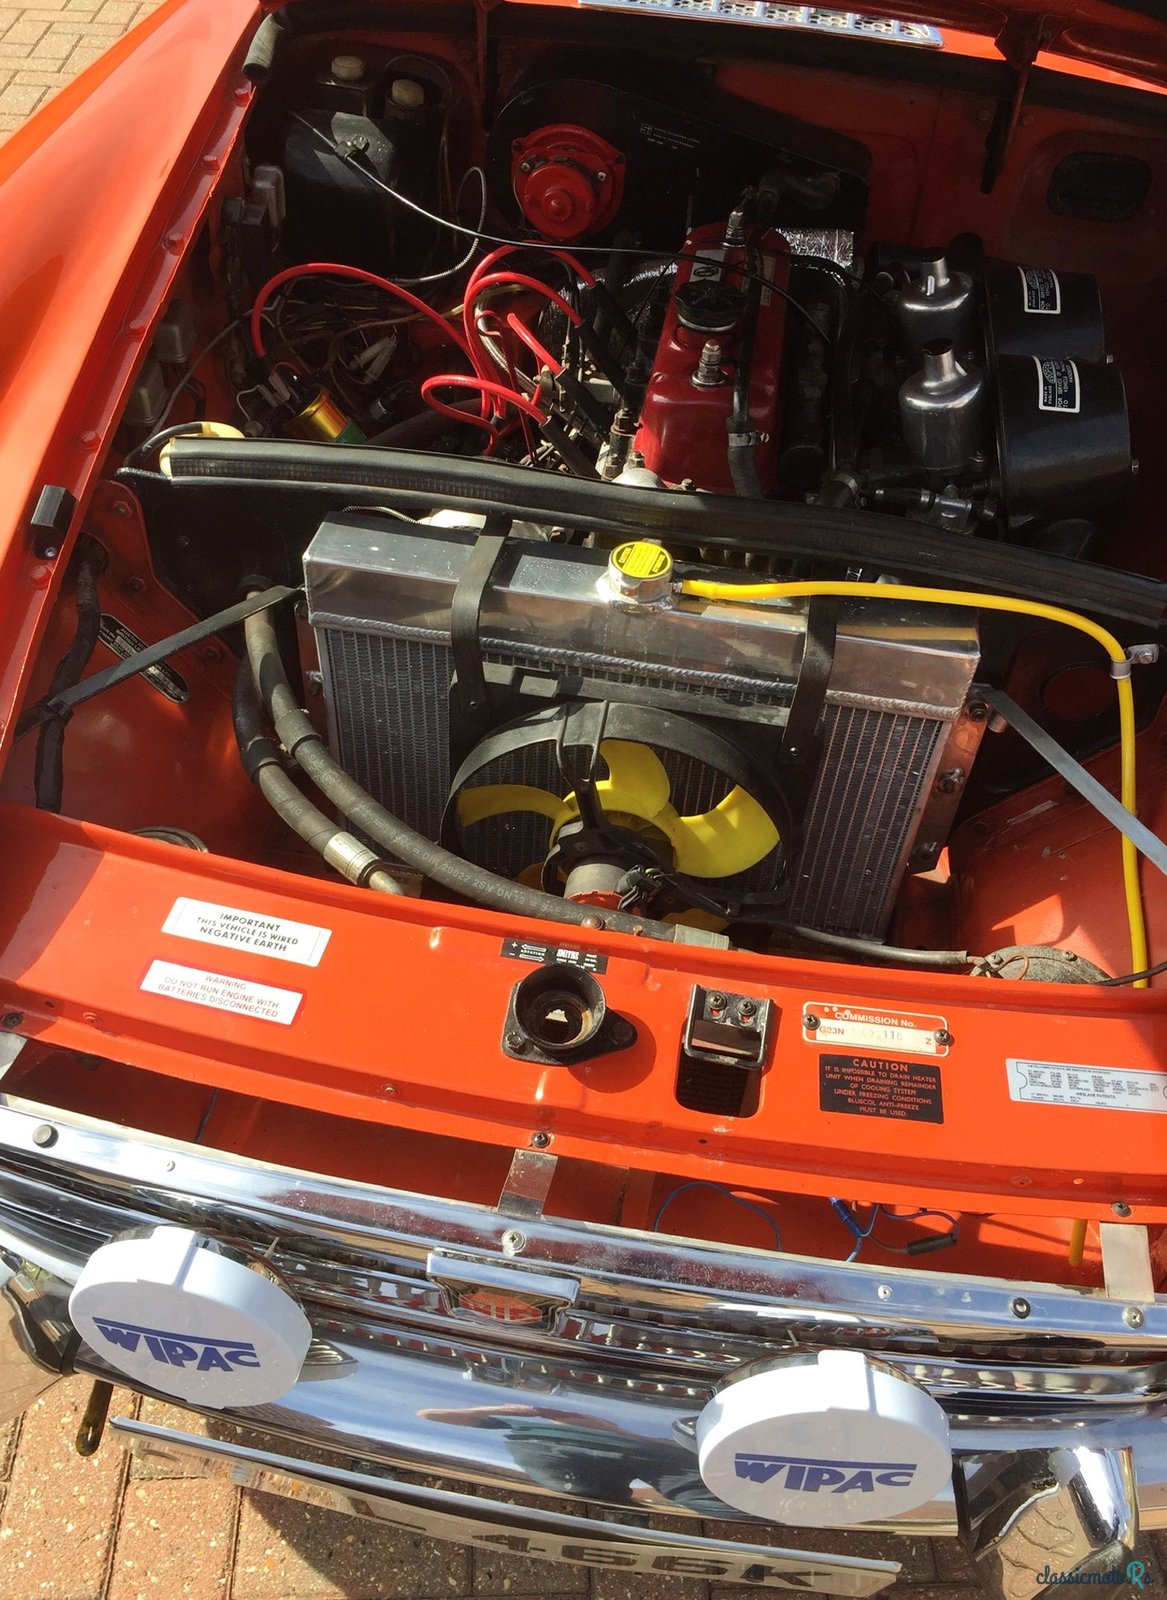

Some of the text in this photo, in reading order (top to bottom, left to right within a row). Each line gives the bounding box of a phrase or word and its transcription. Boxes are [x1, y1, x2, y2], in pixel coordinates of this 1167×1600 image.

[422, 852, 439, 867] DIN
[441, 862, 470, 883] 20022
[472, 878, 494, 893] 2SN
[197, 917, 217, 927] THIS
[220, 921, 256, 936] VEHICLE
[270, 933, 298, 945] WIRED
[220, 913, 281, 932] IMPORTANT
[200, 926, 288, 952] NEGATIVE EARTH
[205, 975, 246, 990] WARNING
[158, 984, 278, 1018] BATTERIES DISCONNECTED
[164, 976, 279, 1009] DO NOT RUN ENGINE WITH
[835, 1012, 898, 1026] COMMISSION
[842, 1067, 875, 1077] IMPOSSIBLE
[853, 1059, 908, 1071] CAUTION
[861, 1084, 890, 1092] COOLING
[867, 1076, 898, 1086] DRAINING
[901, 1081, 936, 1090] REMAINDER
[859, 1091, 889, 1100] FREEZING
[892, 1095, 932, 1104] CONDITIONS
[879, 1101, 919, 1110] ANTI-FREEZE
[96, 1323, 260, 1372] WIPAC
[734, 1459, 914, 1494] WIPAC
